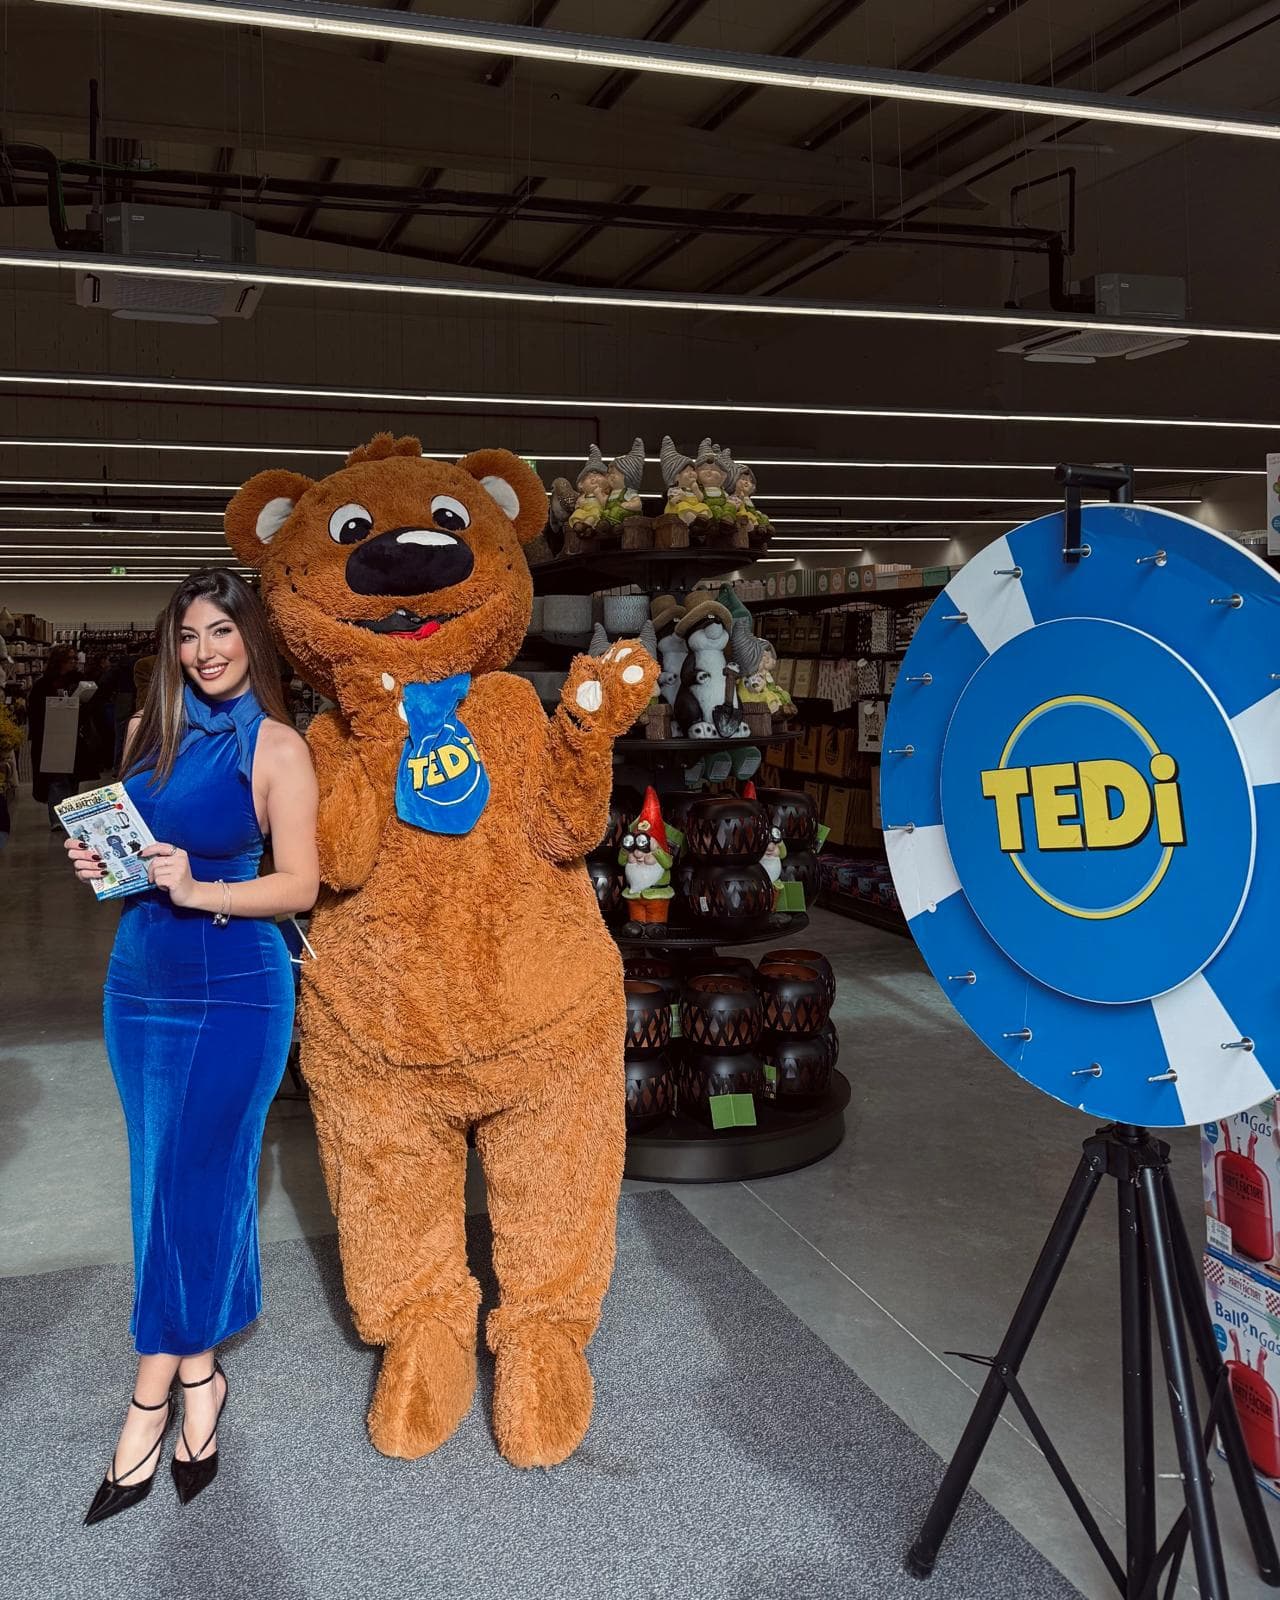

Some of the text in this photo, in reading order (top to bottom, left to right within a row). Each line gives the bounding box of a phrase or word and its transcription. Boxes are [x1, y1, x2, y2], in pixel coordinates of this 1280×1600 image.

[408, 737, 481, 791] TEDi
[981, 752, 1187, 852] TEDi
[1228, 1275, 1261, 1300] PARTY FACTORY
